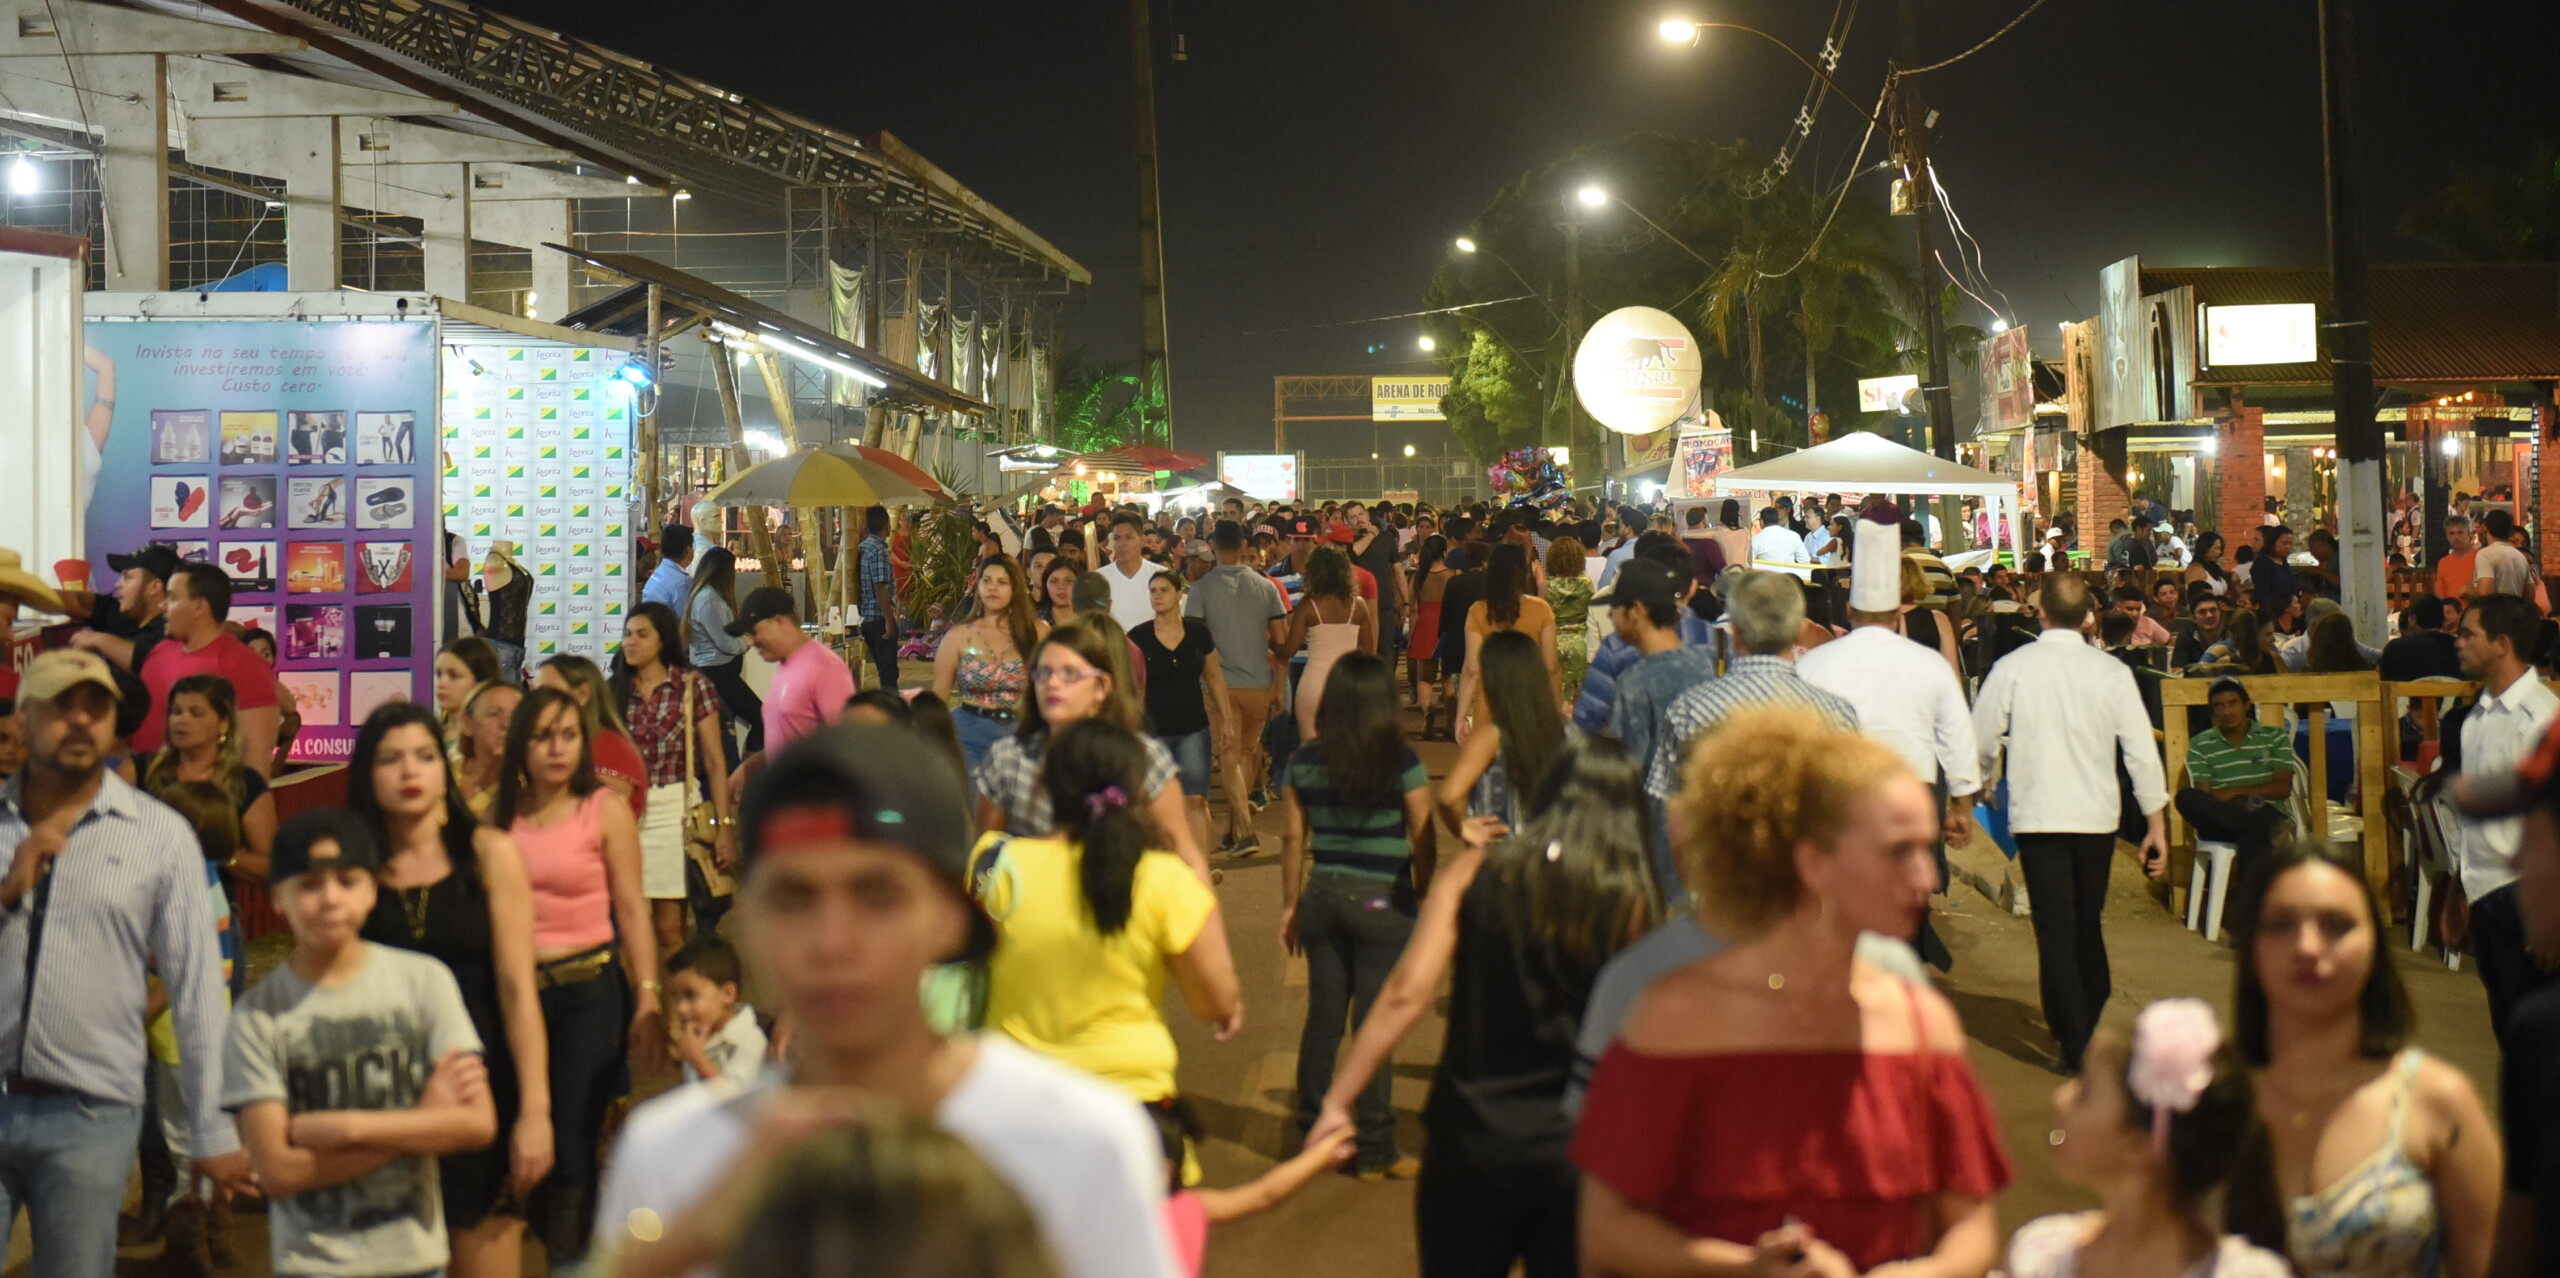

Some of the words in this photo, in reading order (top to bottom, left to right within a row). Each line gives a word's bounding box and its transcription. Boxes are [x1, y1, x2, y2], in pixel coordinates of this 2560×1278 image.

[136, 344, 193, 359] Invista
[202, 348, 222, 359] no
[232, 348, 259, 359] seu
[270, 346, 325, 361] tempo
[174, 361, 282, 377] investiremos
[292, 366, 318, 377] em
[222, 378, 271, 393] Custo
[1376, 384, 1410, 398] ARENA
[1412, 384, 1425, 398] DE
[1428, 384, 1449, 398] ROD
